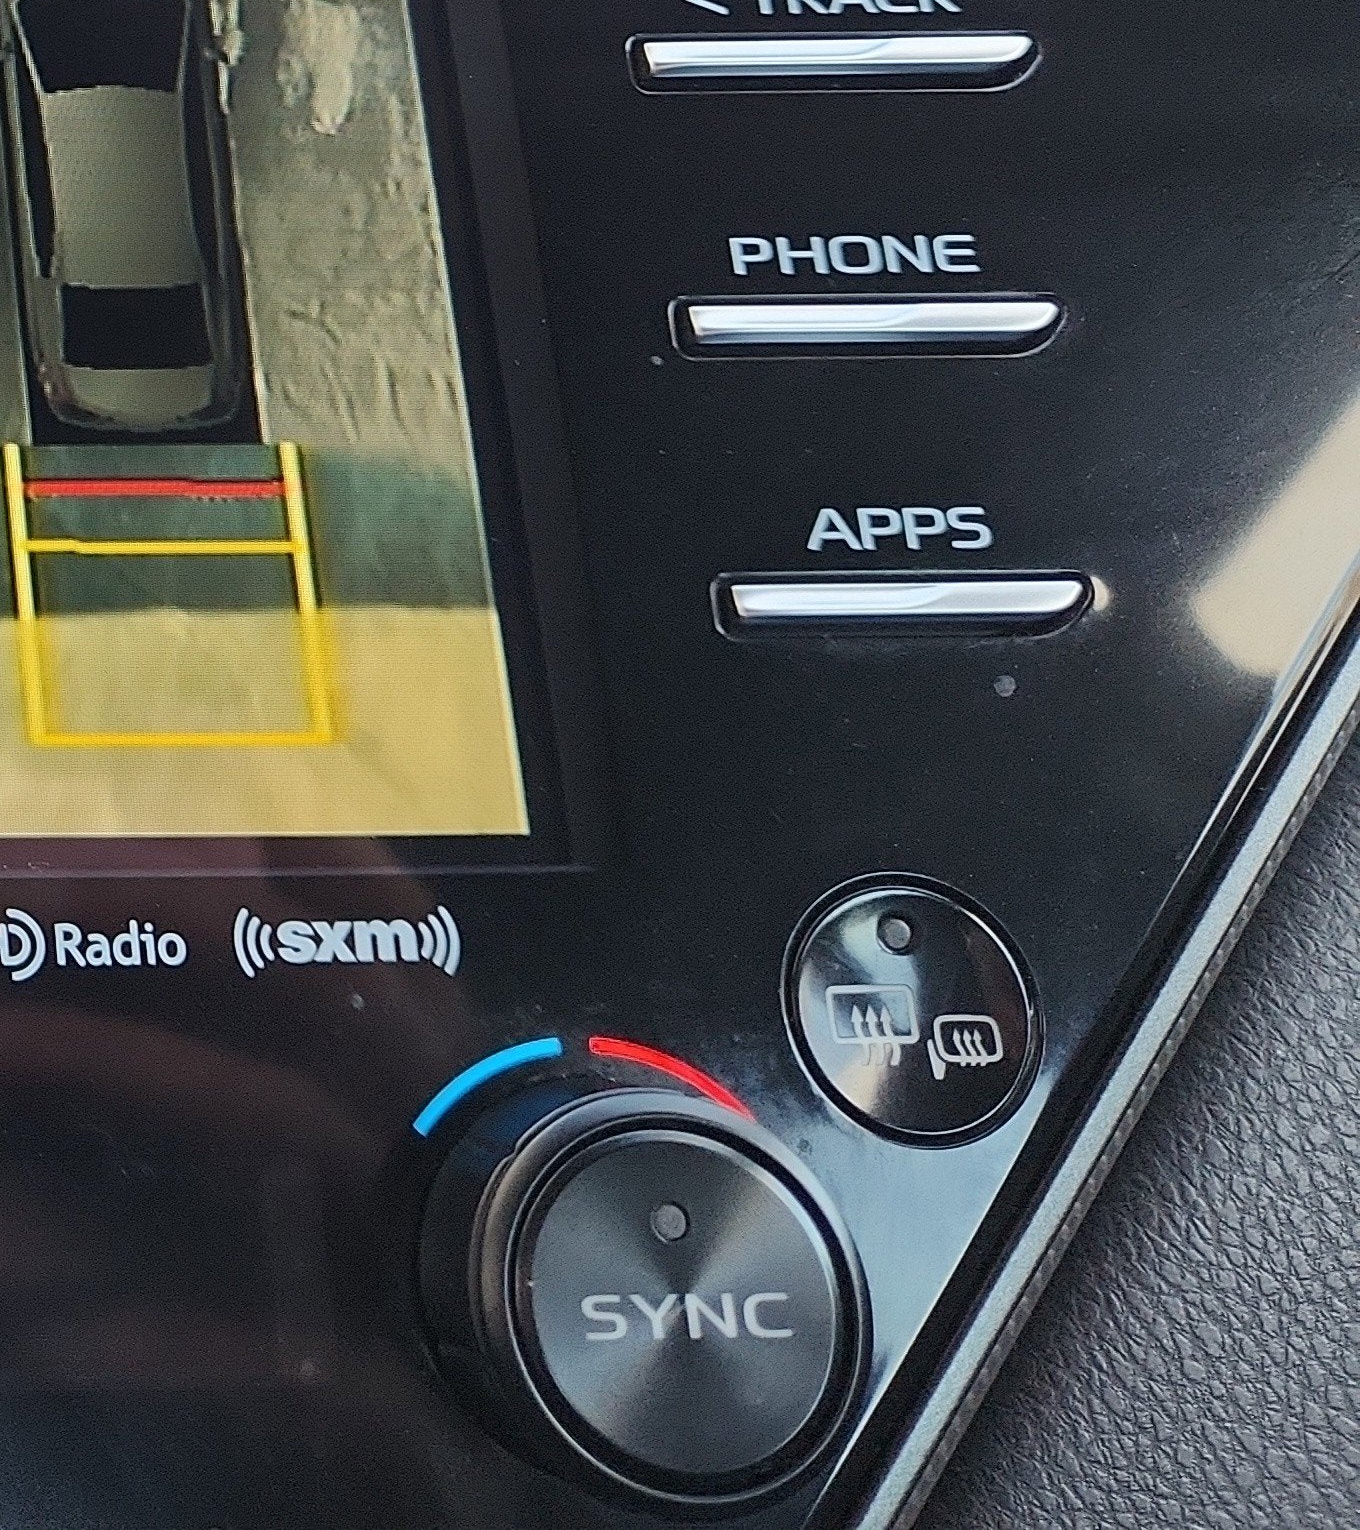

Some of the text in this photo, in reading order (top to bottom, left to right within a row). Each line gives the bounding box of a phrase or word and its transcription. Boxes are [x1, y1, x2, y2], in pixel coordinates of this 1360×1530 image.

[728, 234, 981, 277] PHONE
[806, 506, 993, 552] APPS
[54, 919, 188, 967] Radio
[580, 1292, 794, 1340] SYNC
